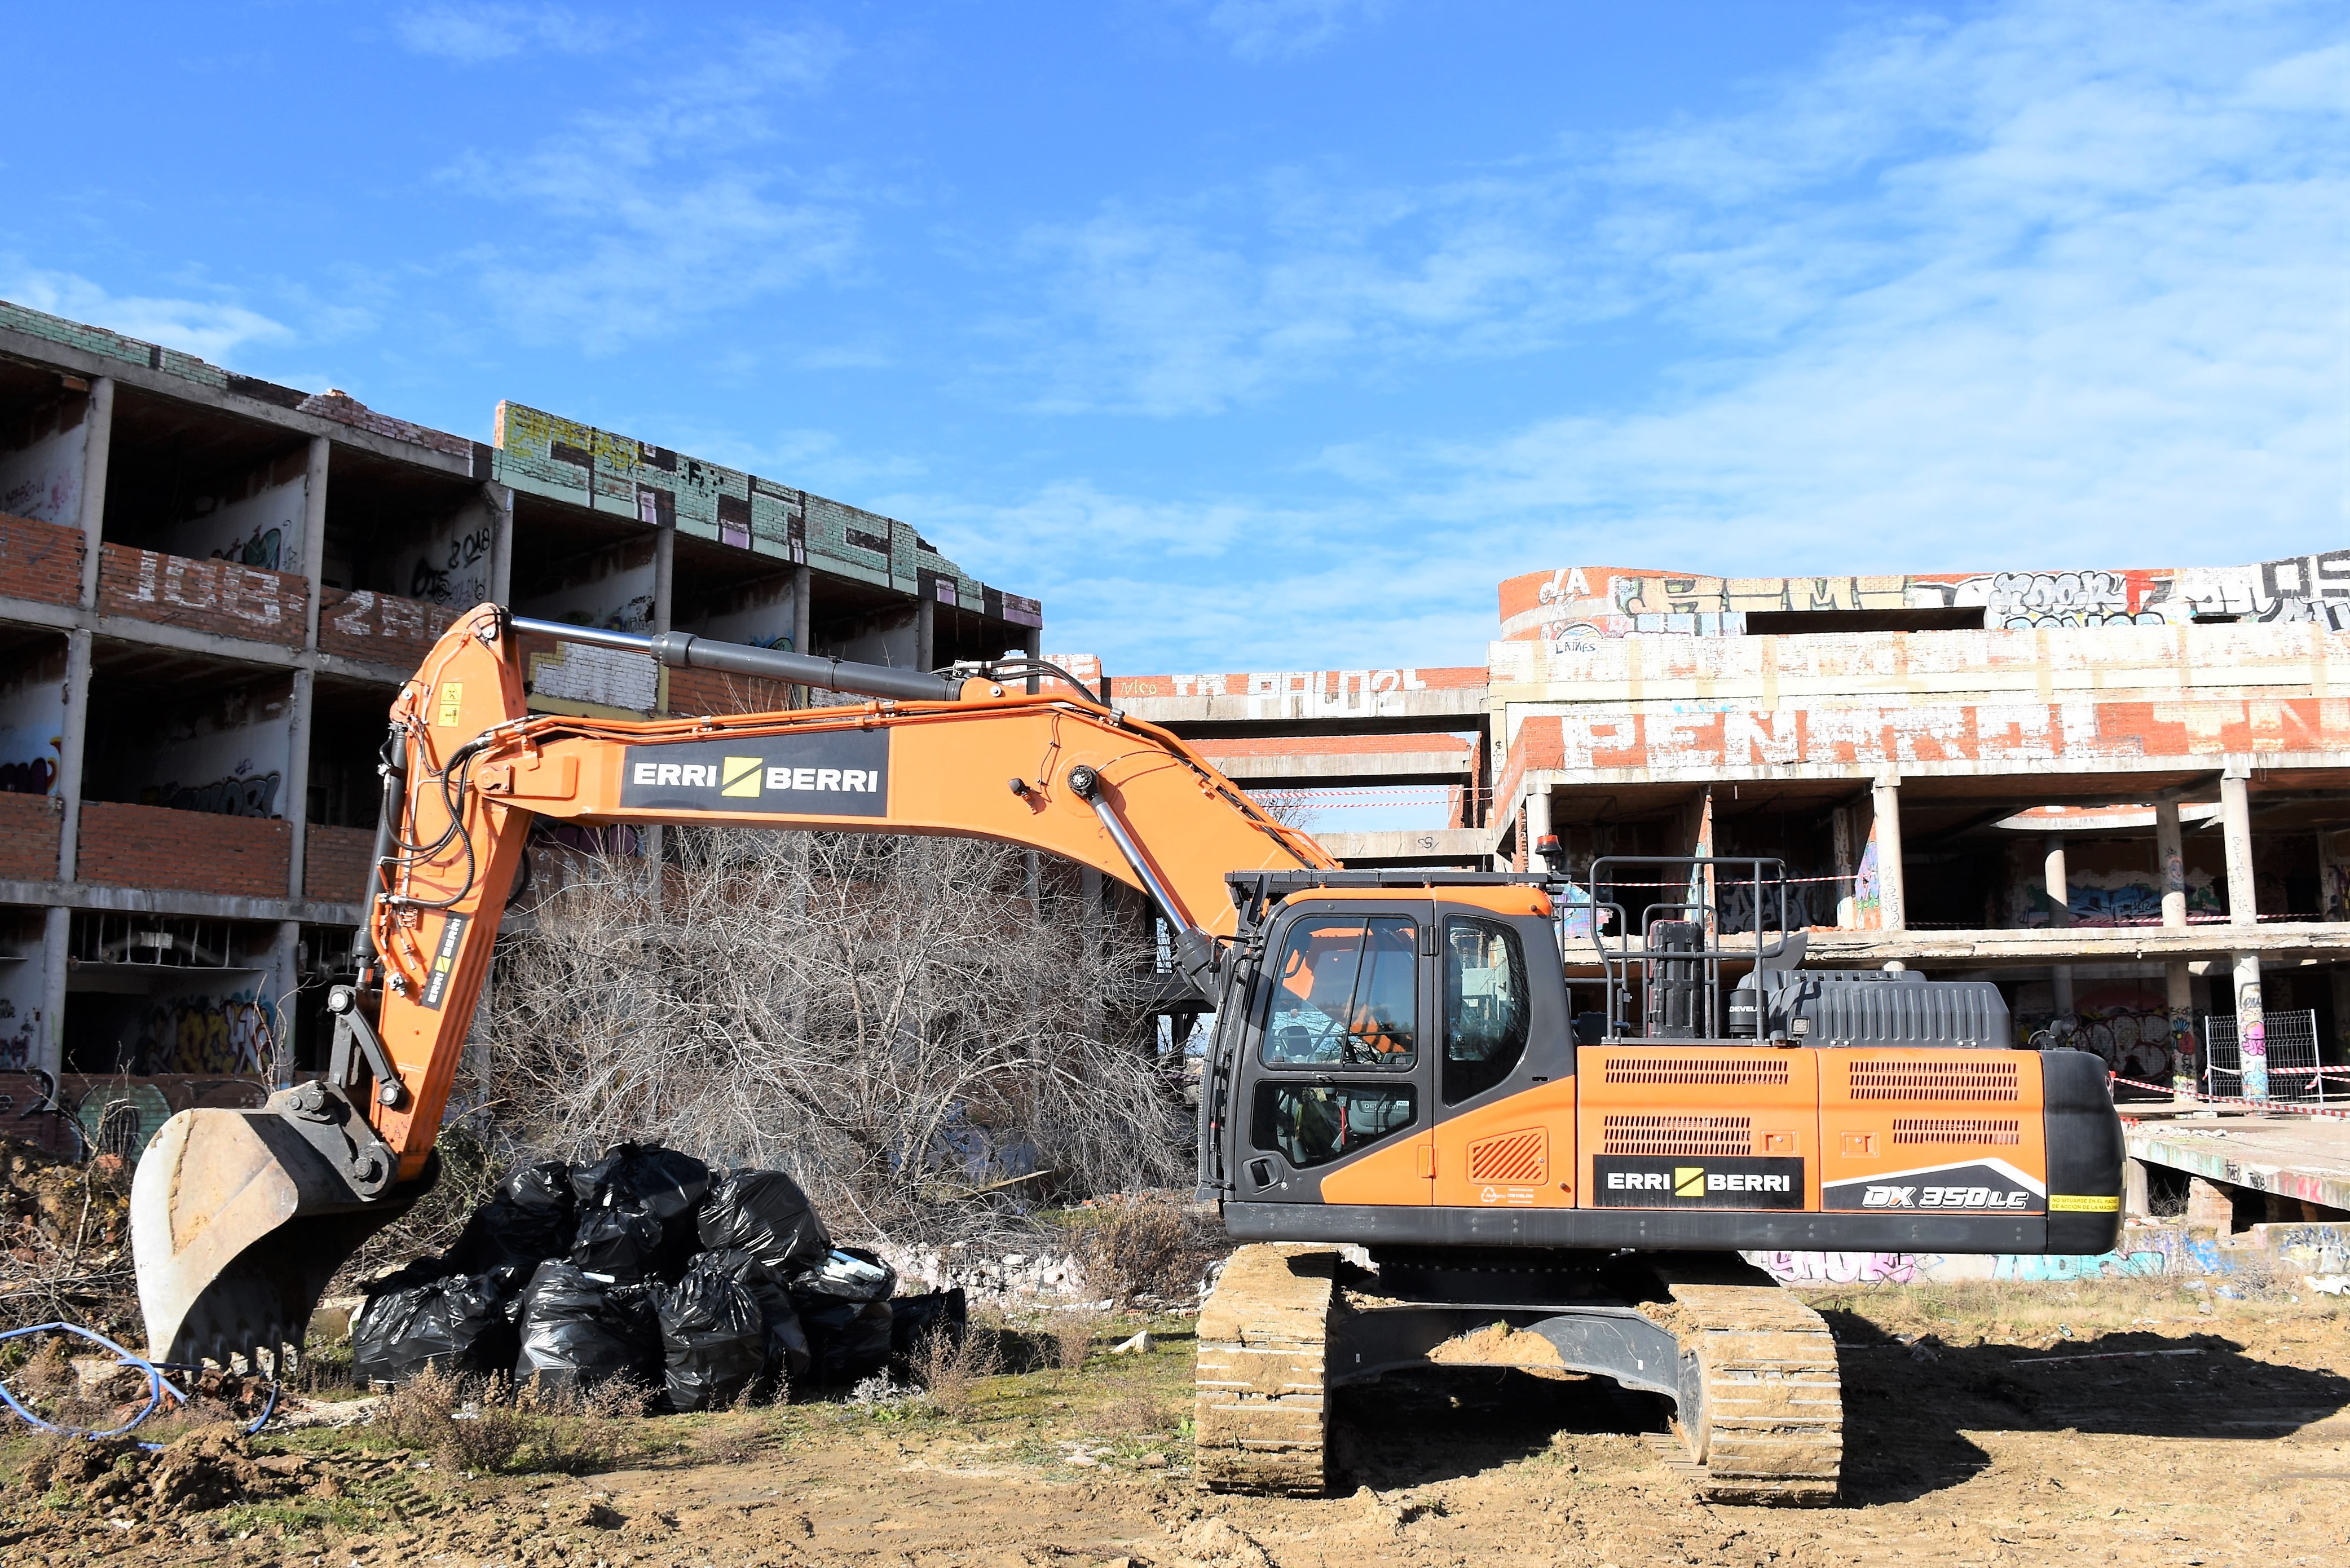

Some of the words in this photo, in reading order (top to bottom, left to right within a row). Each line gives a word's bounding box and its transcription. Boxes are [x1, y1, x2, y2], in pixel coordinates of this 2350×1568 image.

[633, 762, 717, 787] ERRI
[766, 767, 879, 793] BERRI
[427, 971, 444, 1003] ERRI
[442, 918, 461, 957] BERRI
[1607, 1172, 1670, 1190] ERRI
[1707, 1174, 1790, 1192] BERRI
[1862, 1185, 1916, 1209] DX
